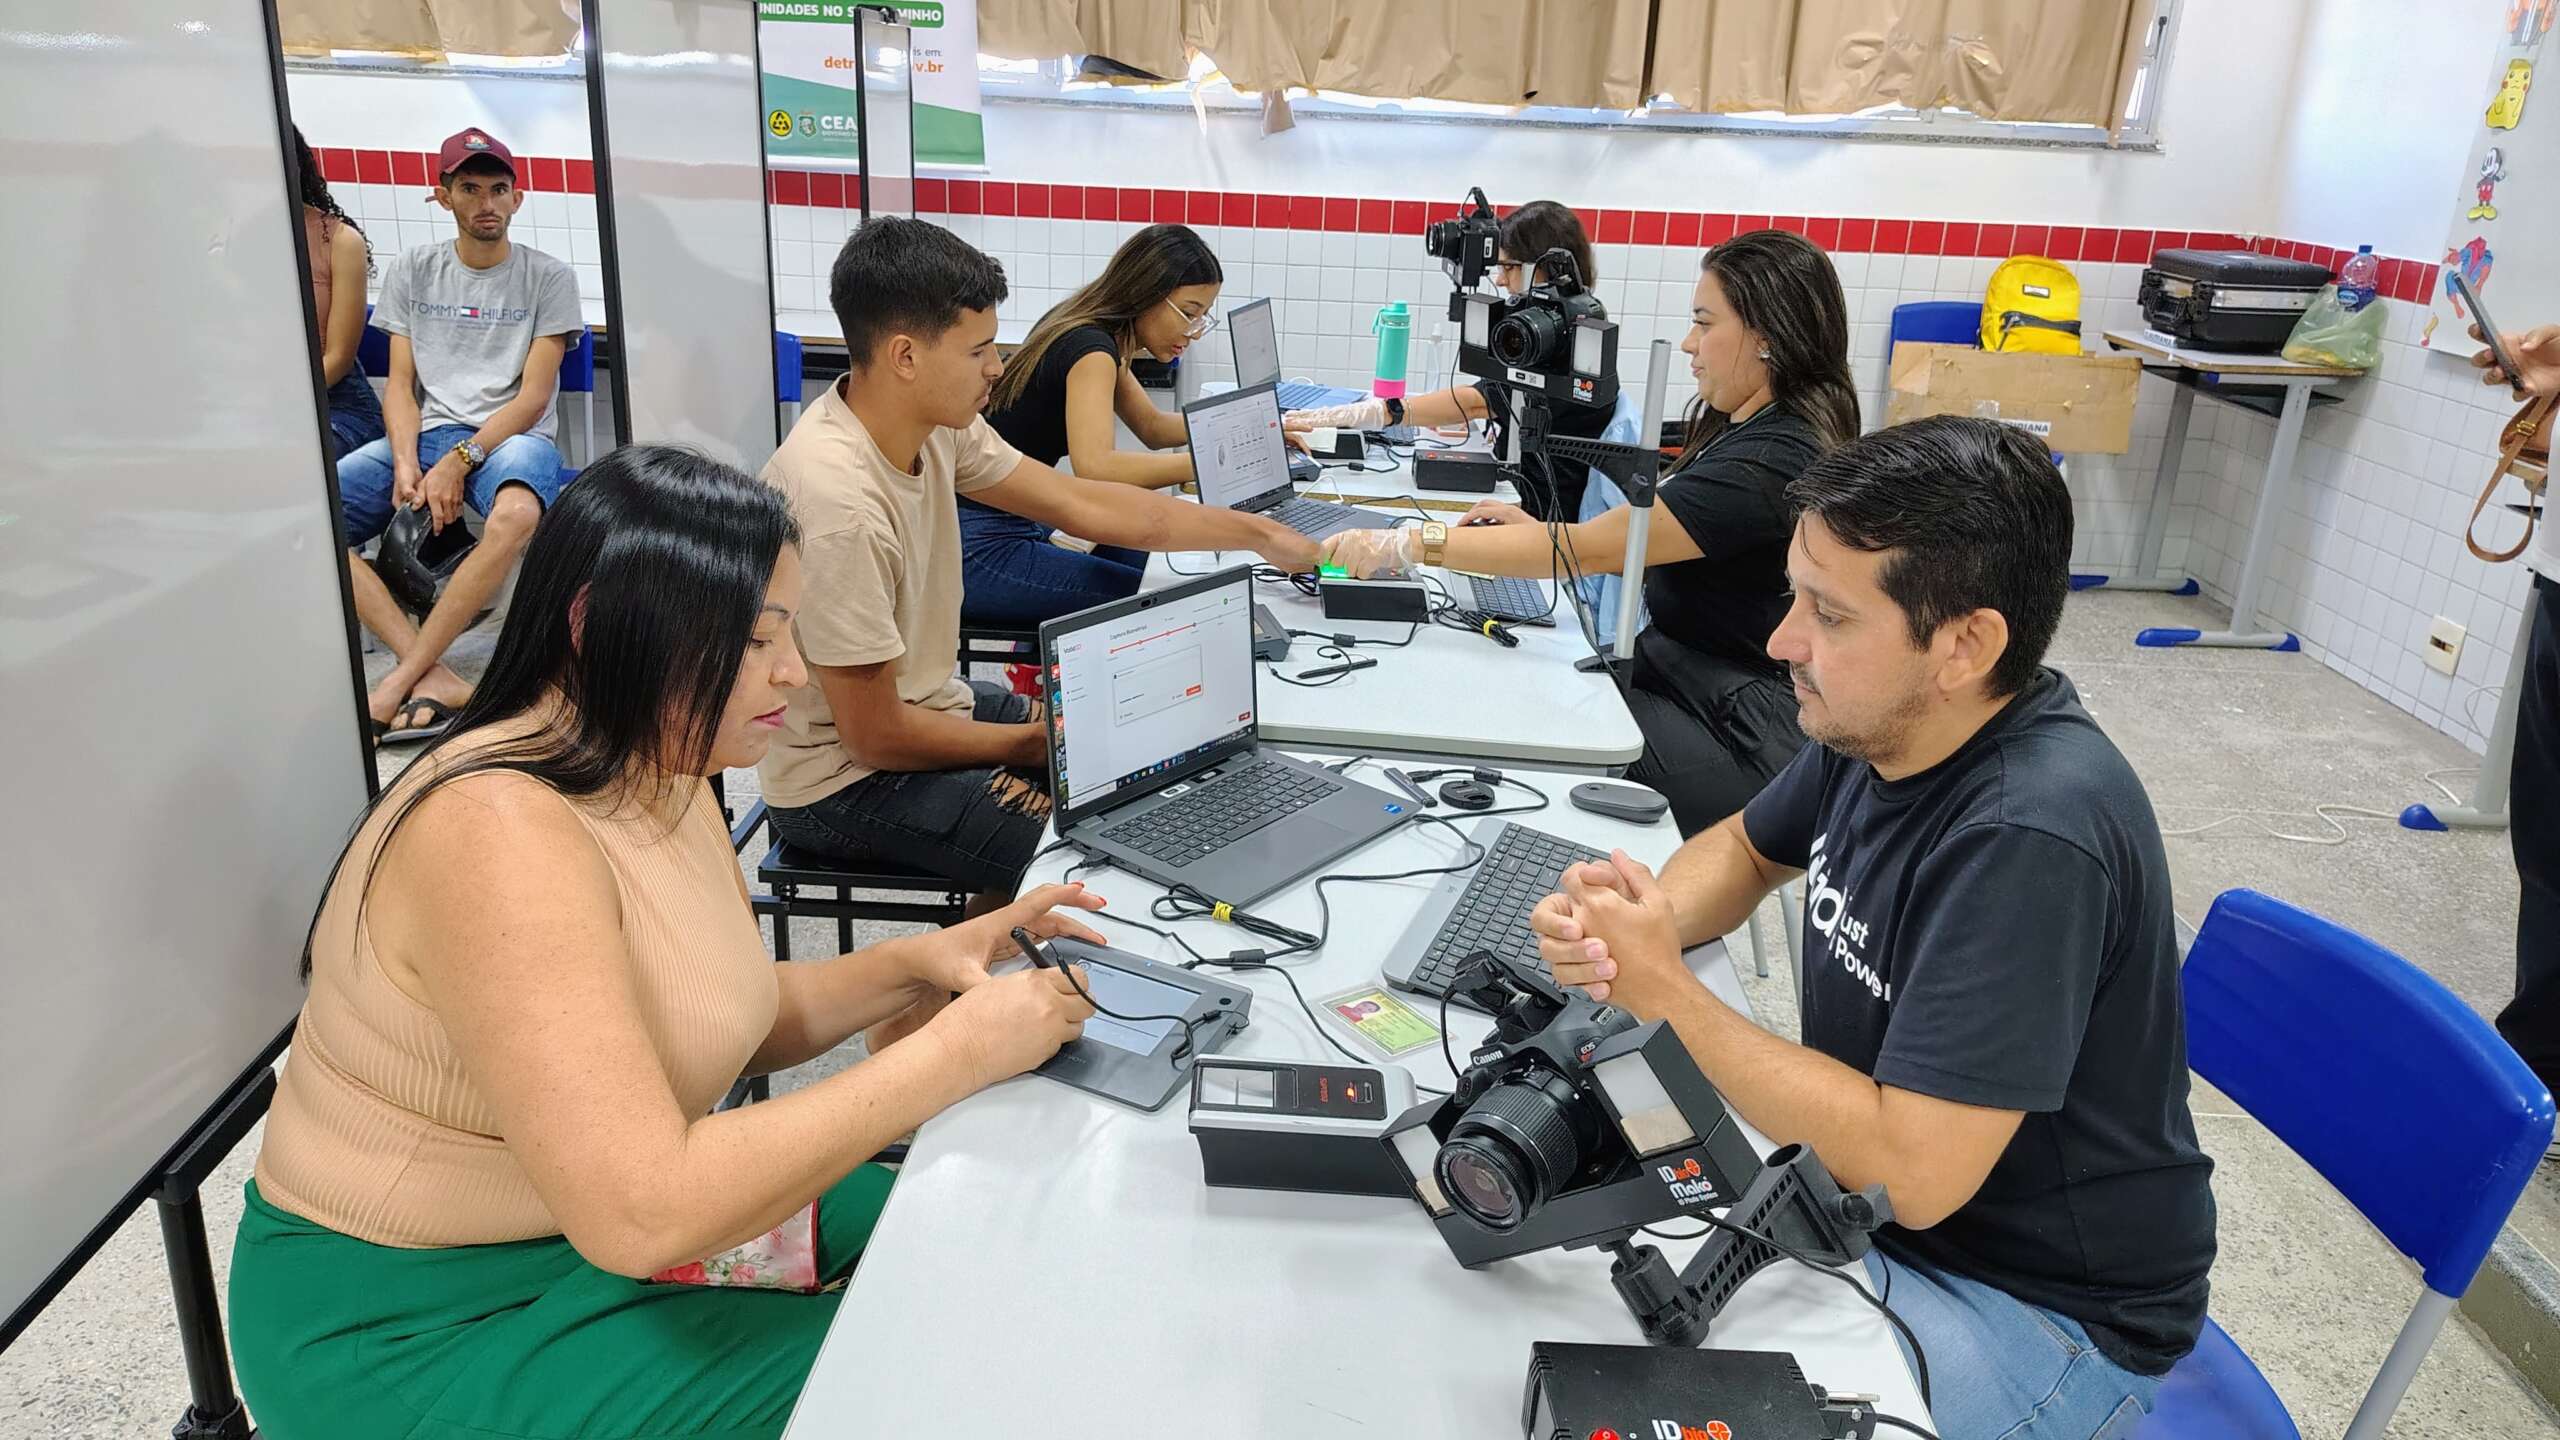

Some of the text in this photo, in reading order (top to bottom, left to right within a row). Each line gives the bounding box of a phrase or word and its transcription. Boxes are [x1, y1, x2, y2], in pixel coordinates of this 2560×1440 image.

[823, 5, 843, 17] NO
[896, 8, 942, 21] MINHO
[820, 115, 858, 131] CEA
[410, 300, 531, 321] TOMMY HILFIG
[1472, 1050, 1504, 1066] Canon
